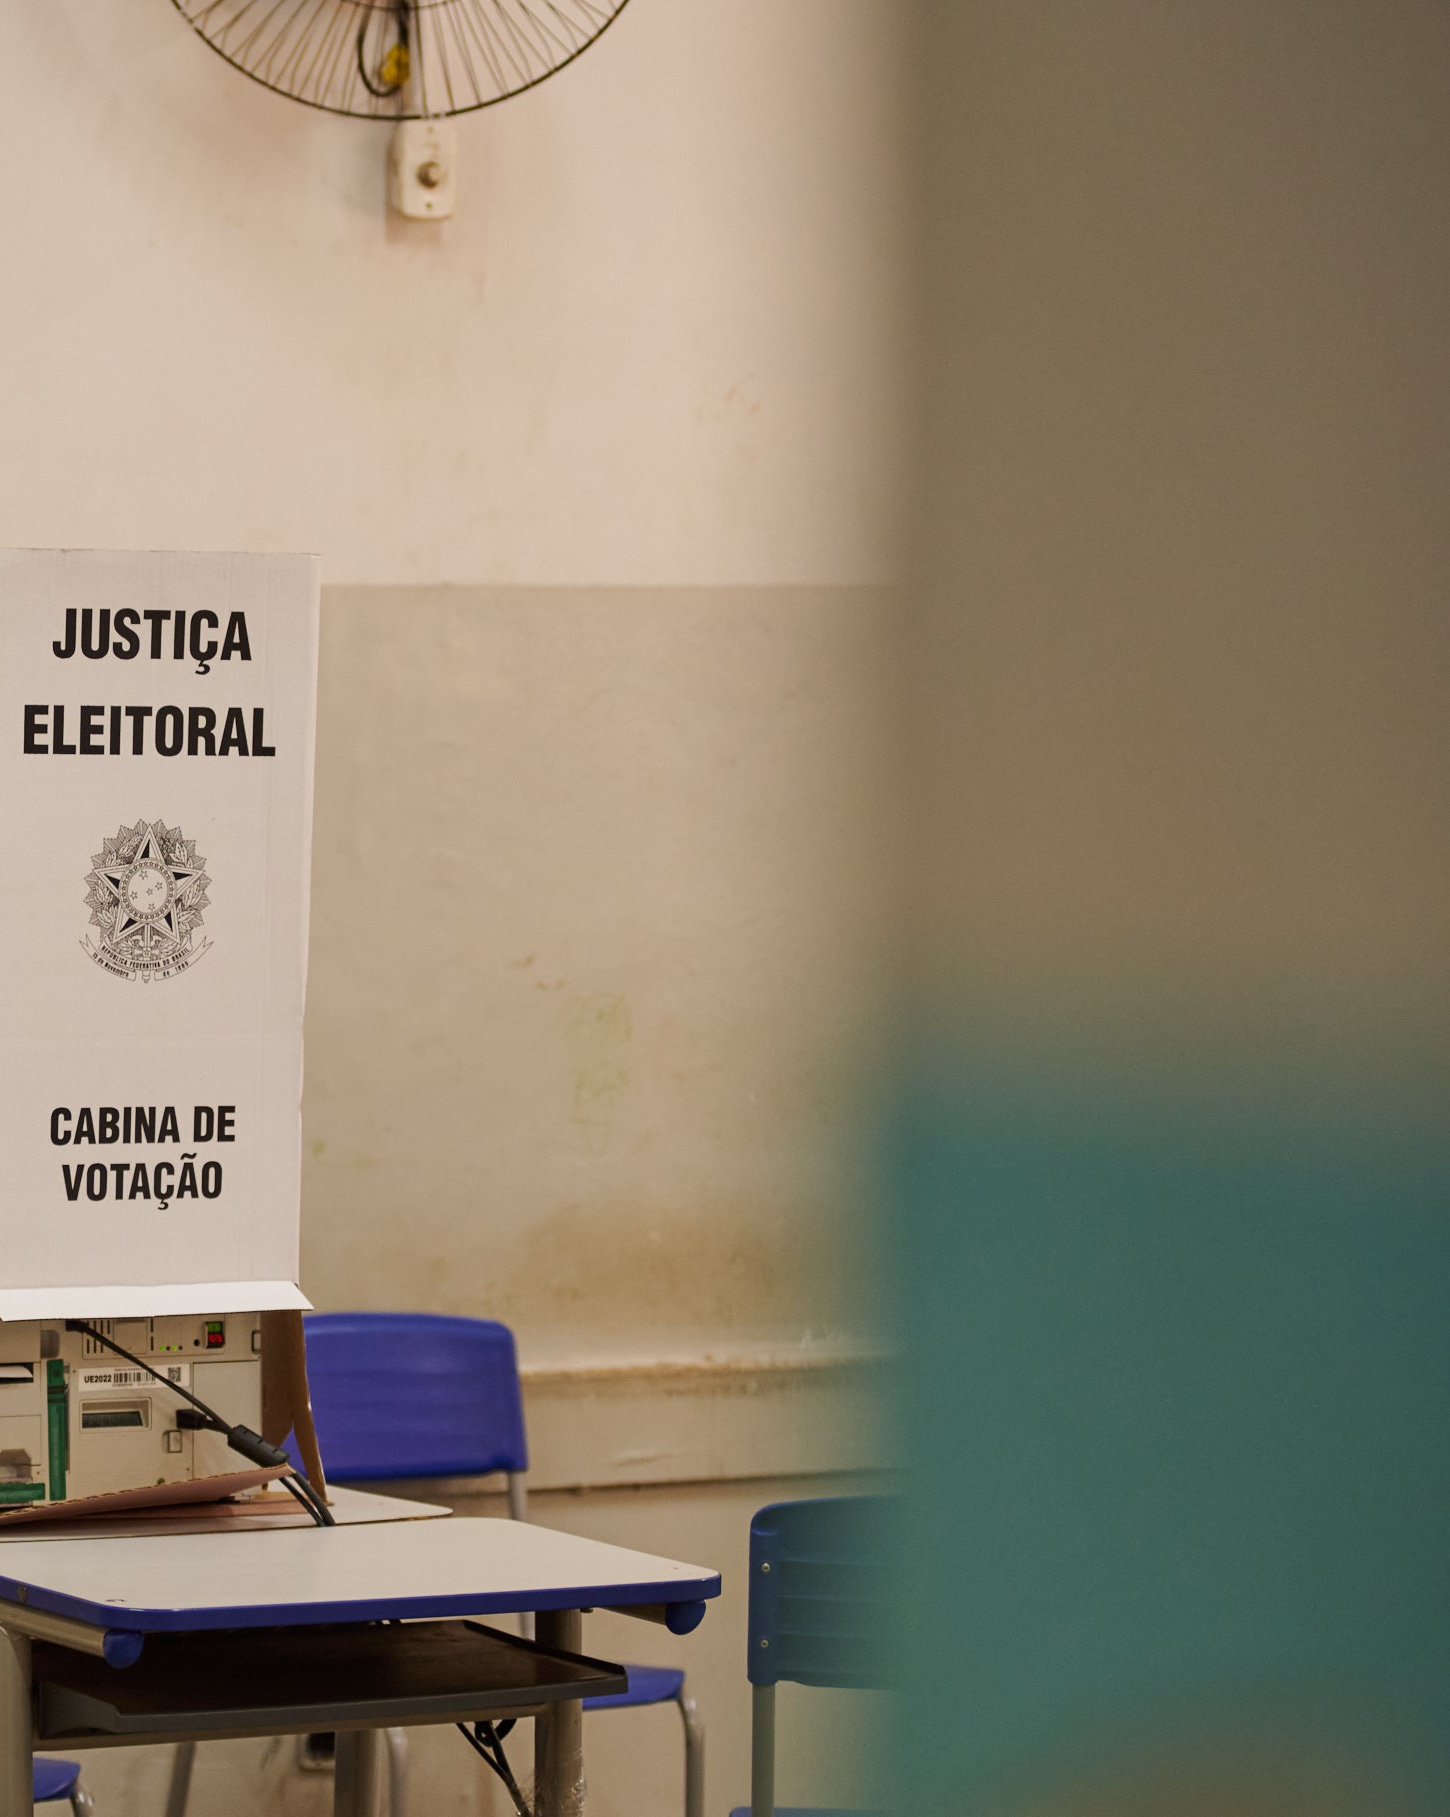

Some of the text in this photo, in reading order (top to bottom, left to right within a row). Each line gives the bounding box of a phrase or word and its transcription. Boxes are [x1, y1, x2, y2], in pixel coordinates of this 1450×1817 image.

[52, 607, 252, 675] JUSTIÇA
[23, 704, 276, 757] ELEITORAL
[50, 1105, 236, 1146] CABINA DE
[61, 1152, 223, 1211] VOTAÇÃO
[84, 1374, 112, 1384] UE2022
